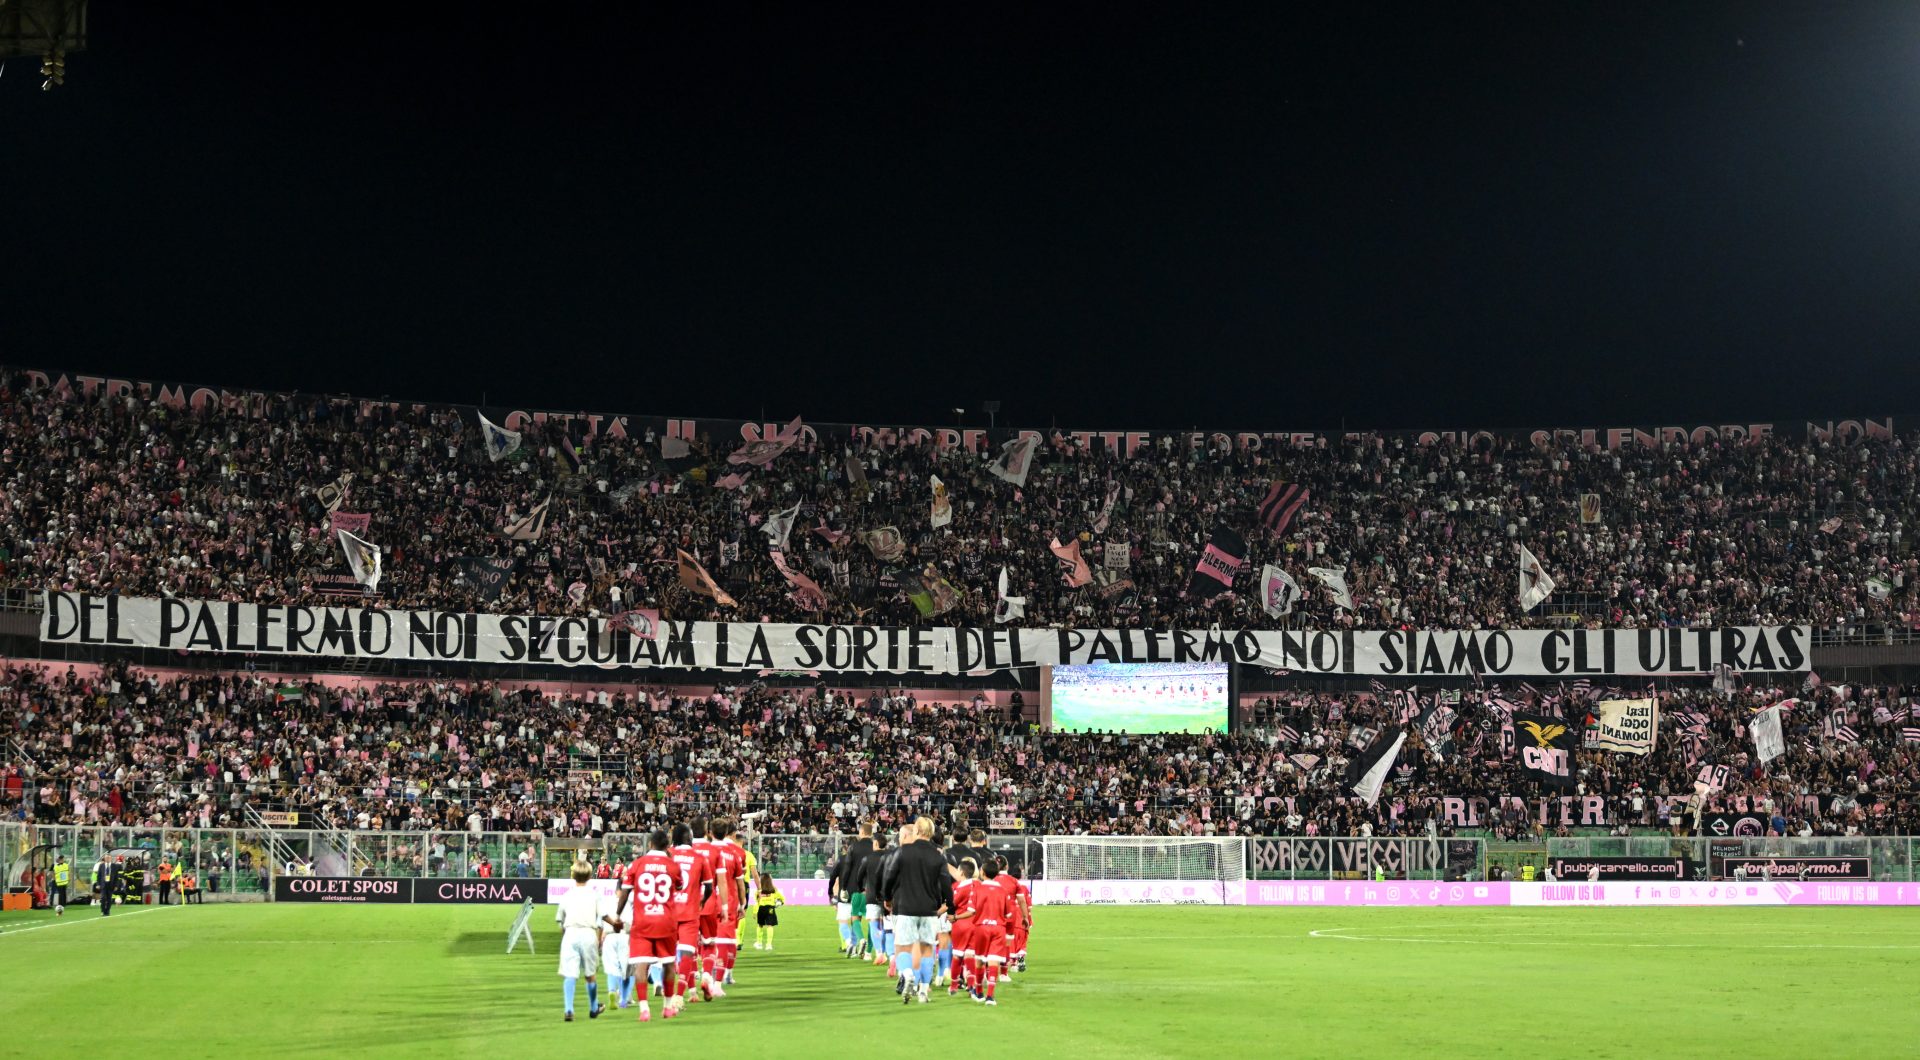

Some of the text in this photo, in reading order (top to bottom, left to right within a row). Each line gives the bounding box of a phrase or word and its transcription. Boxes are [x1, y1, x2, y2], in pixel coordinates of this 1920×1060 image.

[48, 591, 1804, 674] DEL PALERMO NOI SEGUIAM LA SORTE DEL PALERMO NOI SIAMO GLI ULTRAS
[1248, 840, 1326, 871] BORGO
[1336, 841, 1442, 871] VECCHIO
[290, 879, 398, 893] COLET SPOSI
[438, 884, 523, 900] CIURMA
[637, 872, 672, 904] 93
[1542, 885, 1576, 901] FOLLOW
[1578, 885, 1590, 901] US
[1592, 885, 1605, 901] ON
[1817, 886, 1849, 901] FOLLOW
